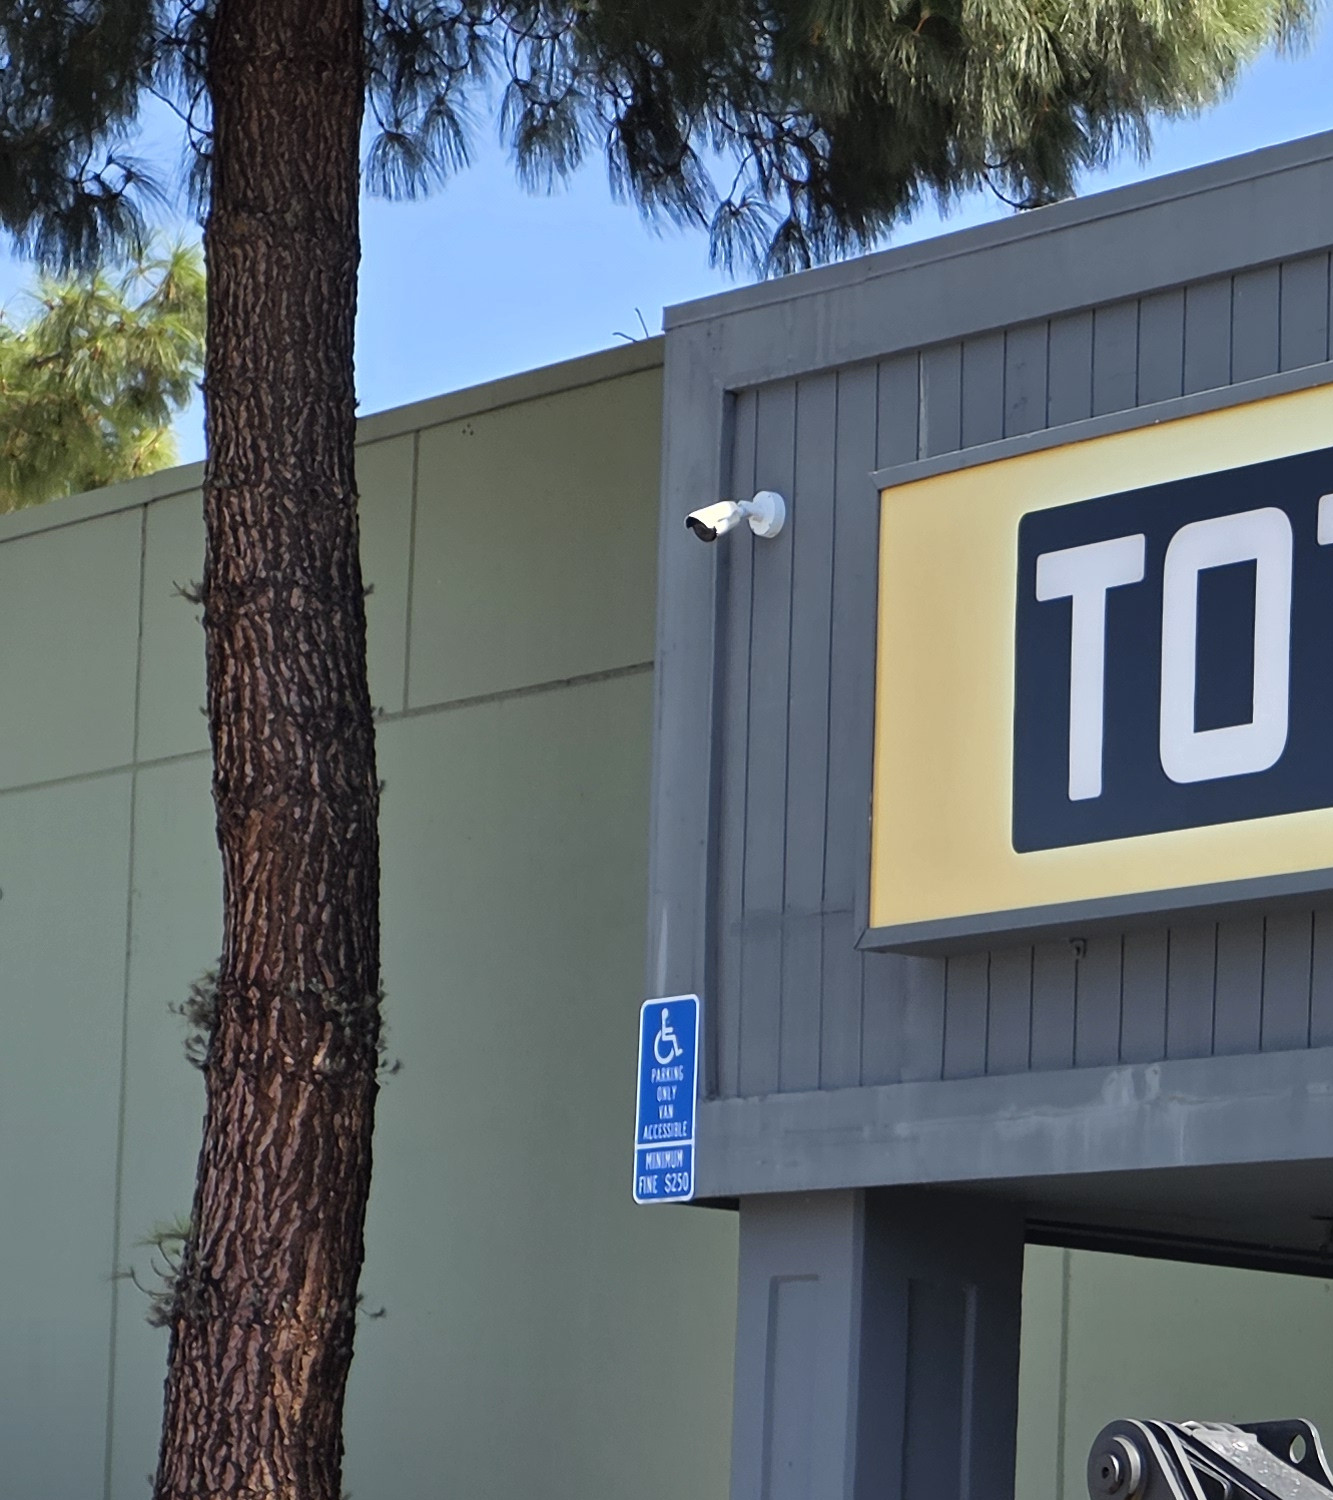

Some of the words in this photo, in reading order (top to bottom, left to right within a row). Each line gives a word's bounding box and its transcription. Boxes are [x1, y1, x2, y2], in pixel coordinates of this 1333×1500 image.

[651, 1065, 684, 1084] PARKING
[656, 1085, 677, 1102] ONLY
[659, 1104, 674, 1119] VAN
[643, 1121, 688, 1139] ACCESSIBLE
[645, 1150, 684, 1170] MINIMUM
[639, 1175, 658, 1194] FINE
[664, 1172, 689, 1194] $250
